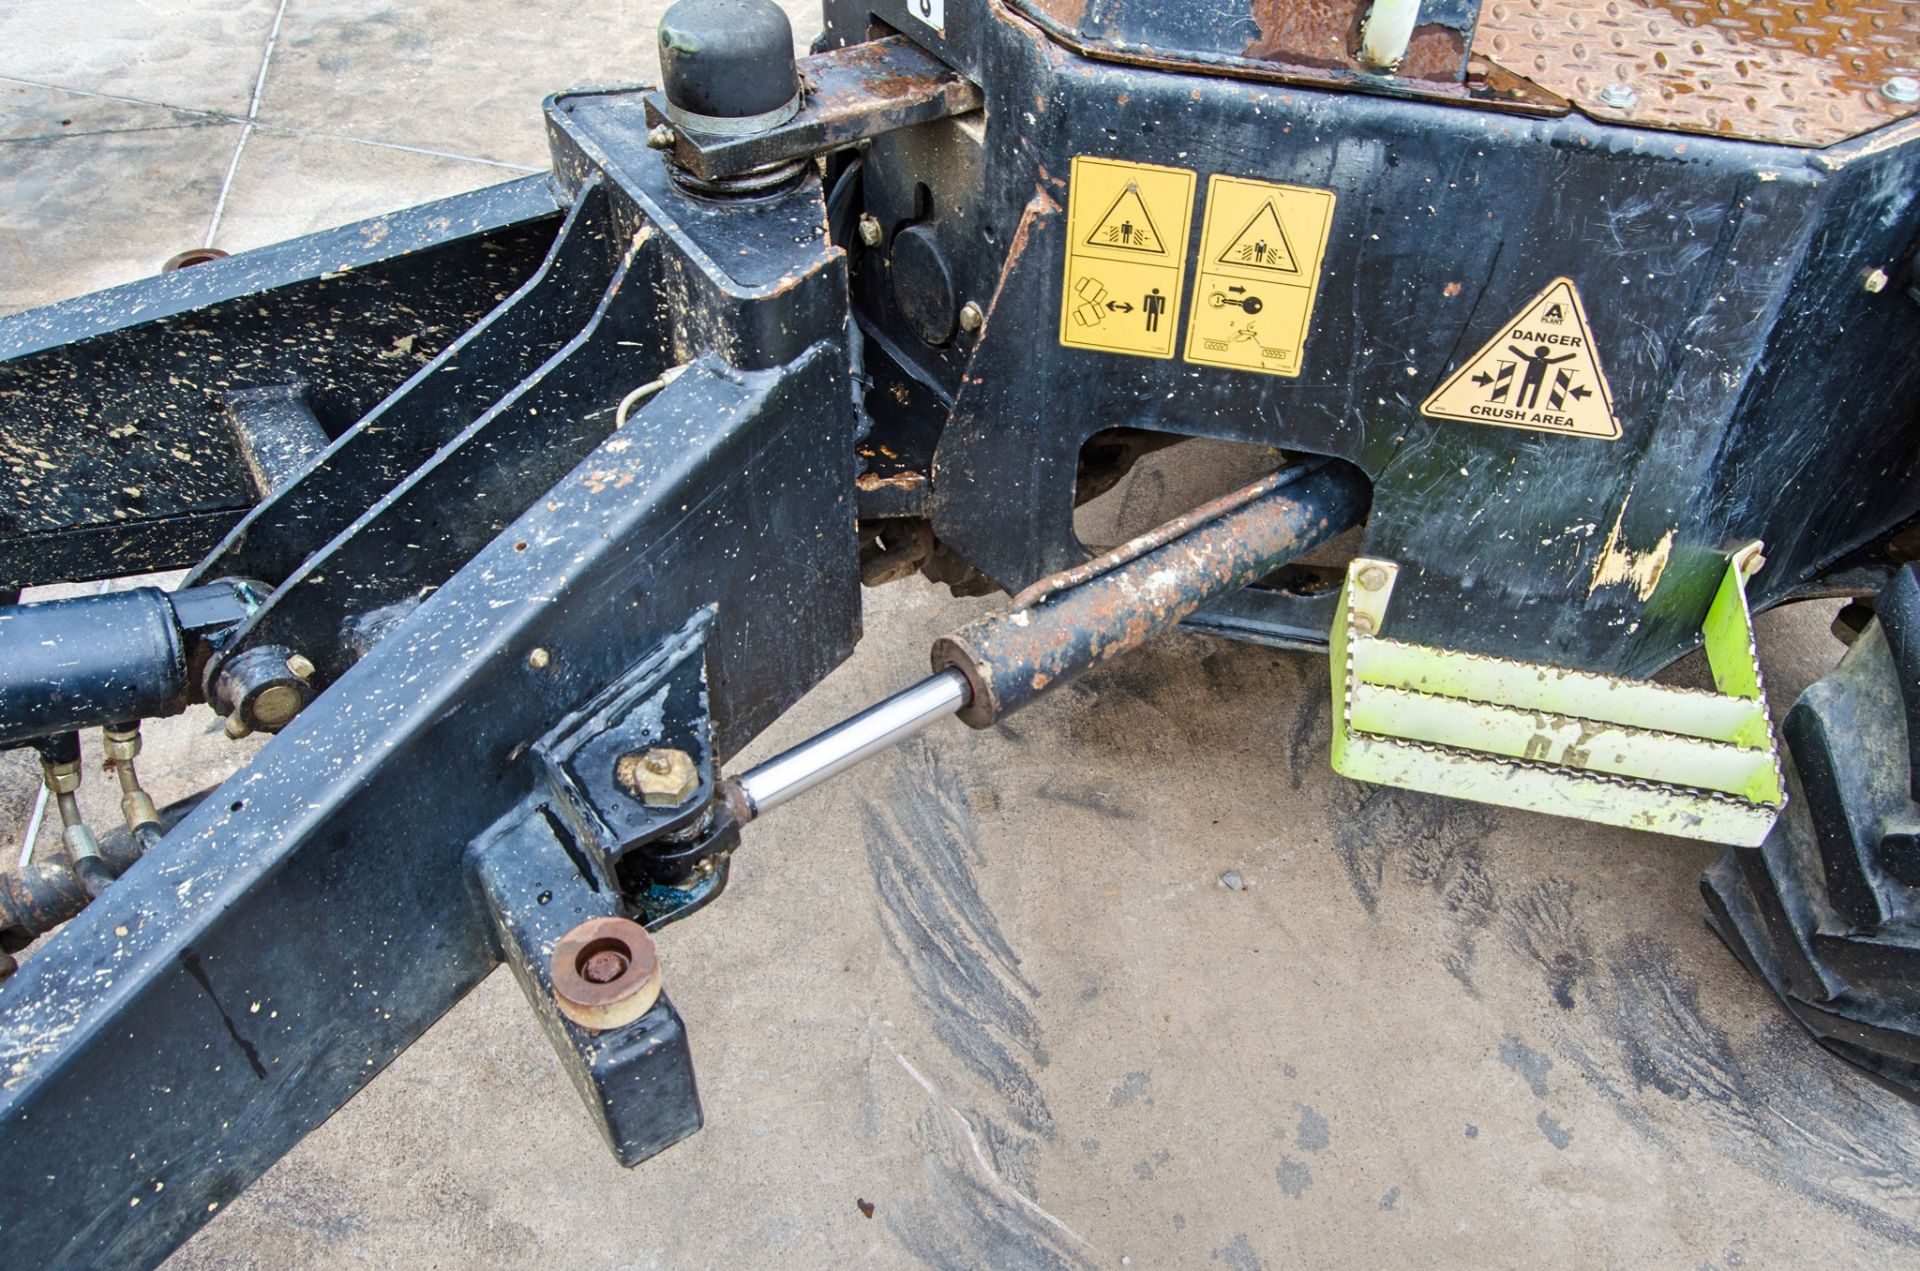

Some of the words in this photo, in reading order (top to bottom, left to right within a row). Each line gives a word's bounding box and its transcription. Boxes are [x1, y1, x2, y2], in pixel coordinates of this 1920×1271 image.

[1545, 303, 1563, 318] A
[1541, 316, 1564, 325] PLANT
[1511, 329, 1582, 347] DANGER
[1470, 405, 1527, 421] CRUSH
[1530, 412, 1575, 428] AREA
